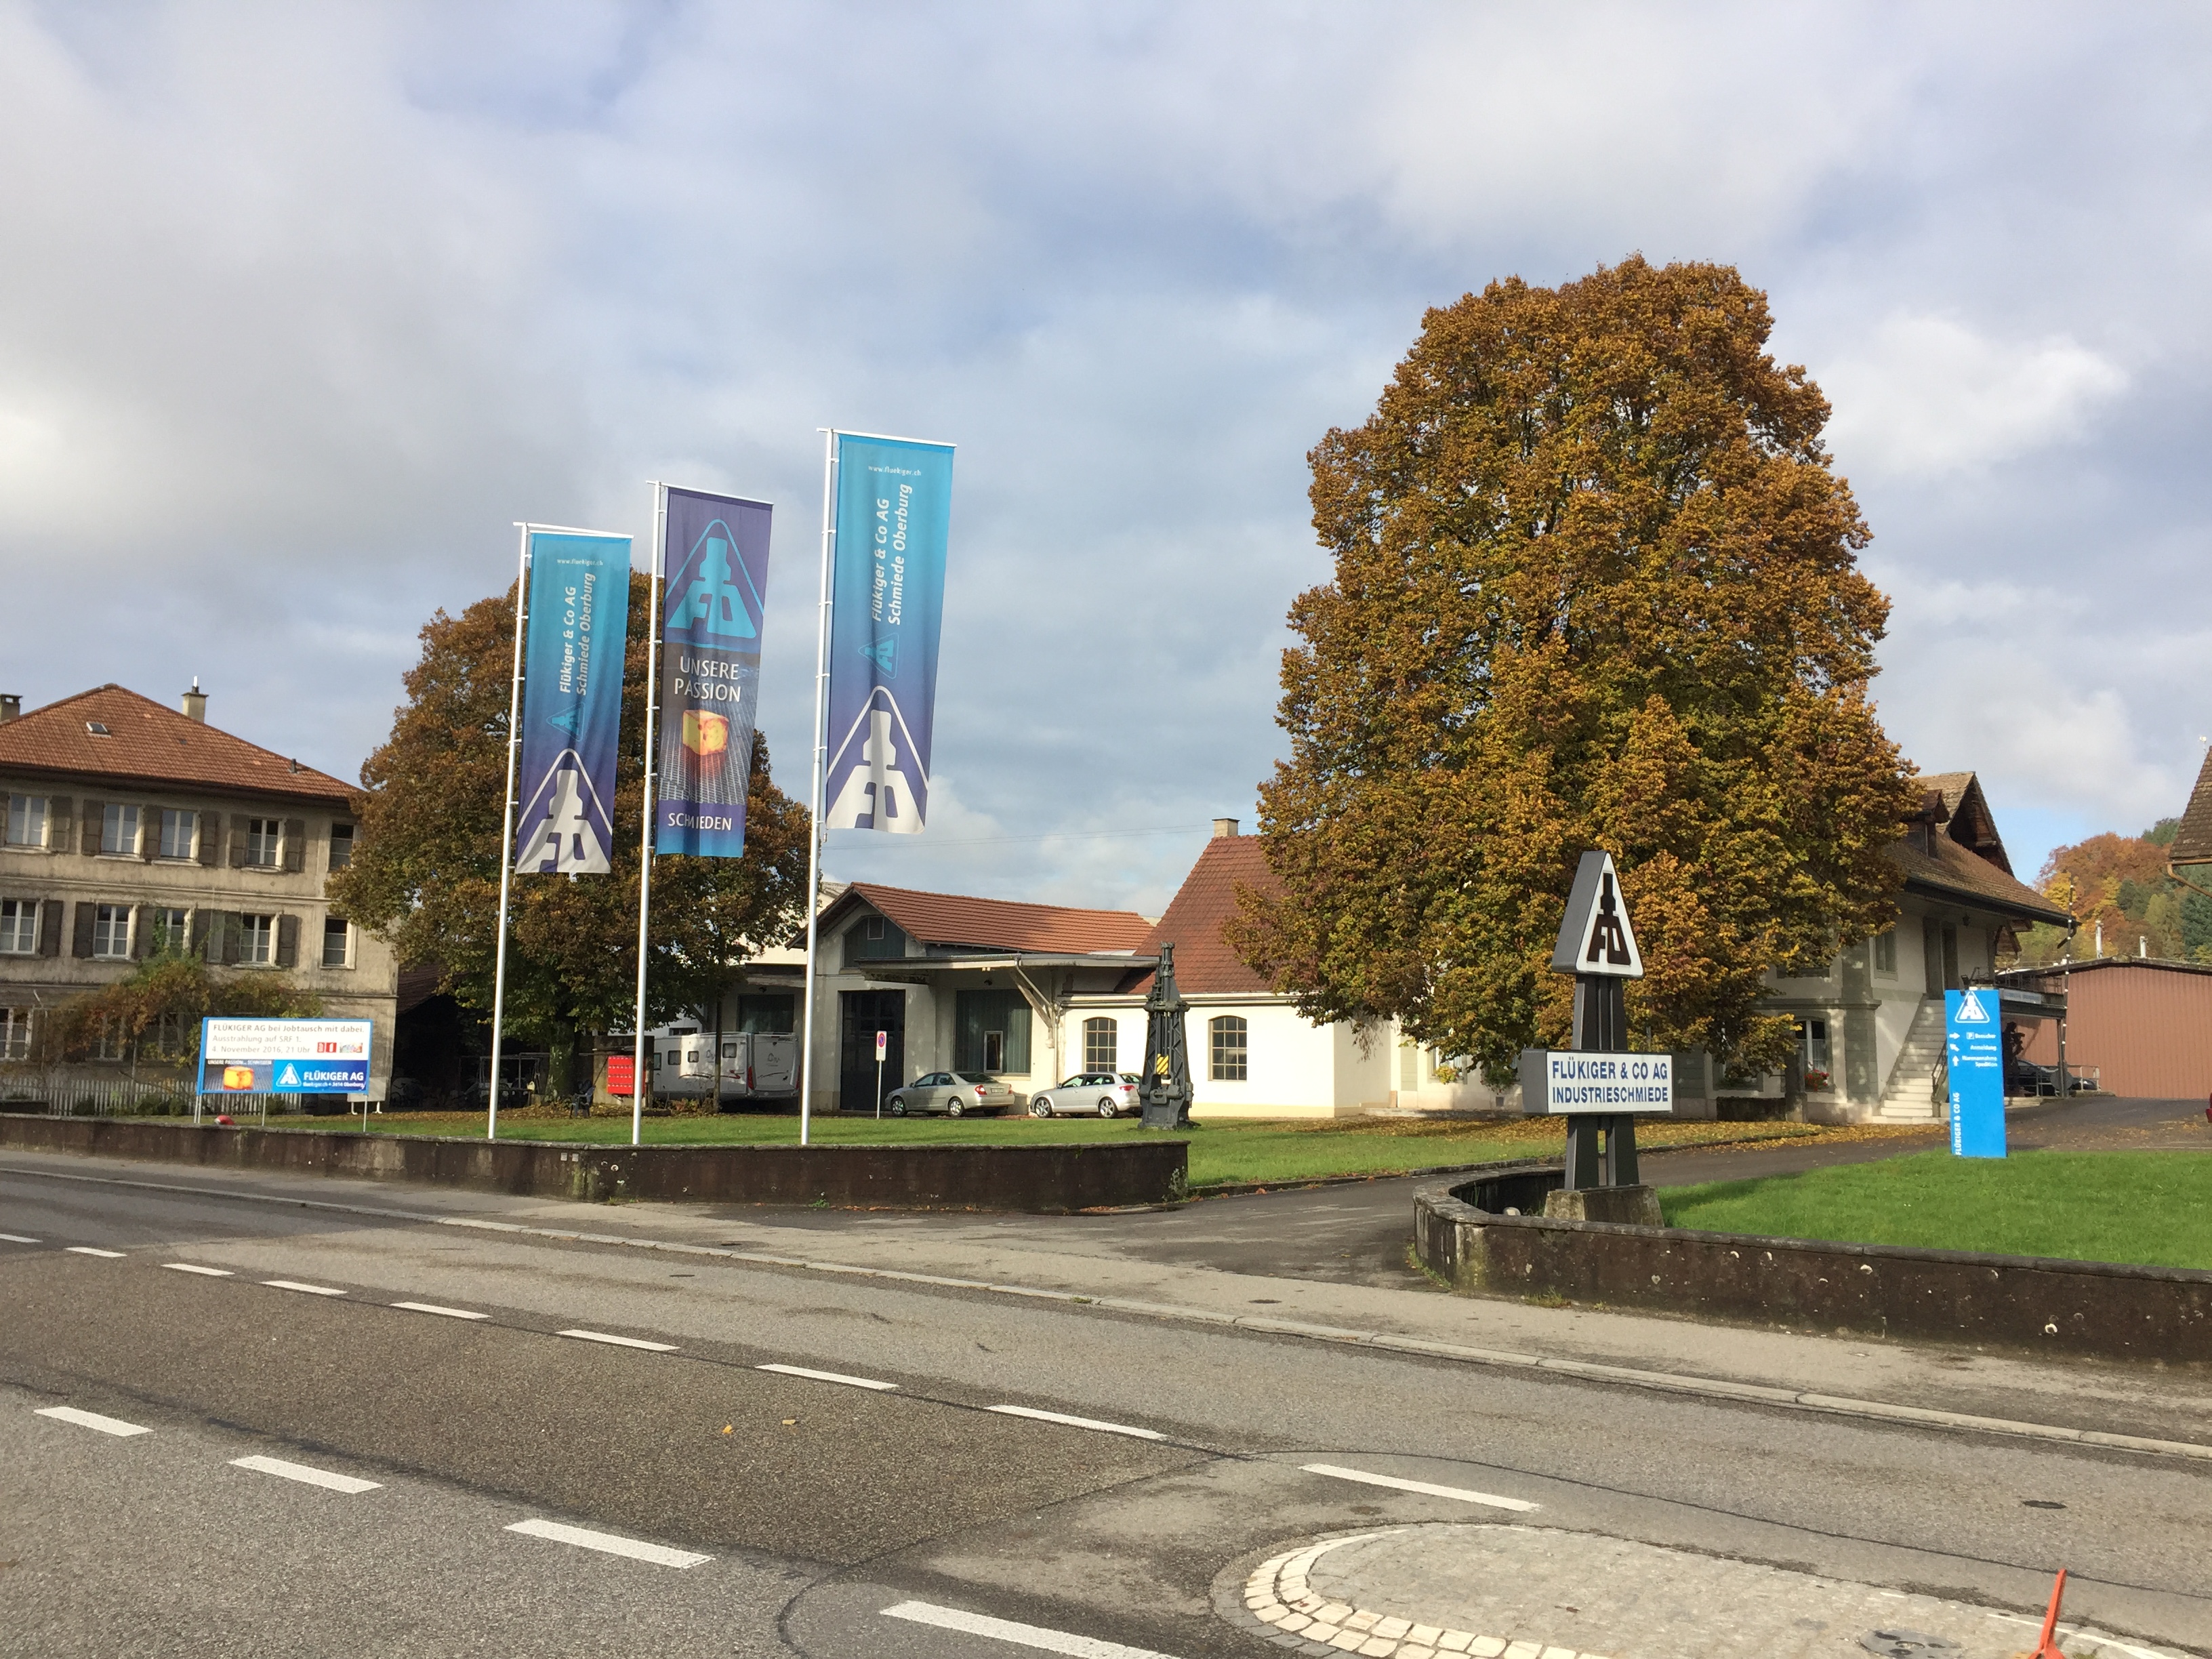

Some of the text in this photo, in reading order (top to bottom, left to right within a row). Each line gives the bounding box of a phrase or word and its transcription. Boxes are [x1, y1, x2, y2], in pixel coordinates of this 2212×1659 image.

[868, 466, 921, 476] www.fluekiger.ch
[872, 499, 889, 621] Flükiger & Co AG
[888, 483, 913, 625] Schmiede Oberburg
[559, 586, 576, 693] Flükiger & Co AG
[577, 573, 596, 695] Schmiede Oberburg
[680, 656, 739, 680] UNSERE
[674, 678, 741, 702] PASSION
[668, 813, 731, 831] SCHMIEDEN
[213, 1023, 251, 1031] FLÜKIGER
[212, 1036, 262, 1044] Ausstrahlung
[304, 1070, 364, 1081] FLÜKIGER AG
[1552, 1056, 1668, 1080] FLÜKIGER & CO AG
[1553, 1086, 1668, 1103] INDUSTRIESCHMIEDE
[1952, 1092, 1960, 1103] AG
[1953, 1103, 1960, 1113] CO
[1954, 1122, 1962, 1155] FLÜKIGER
